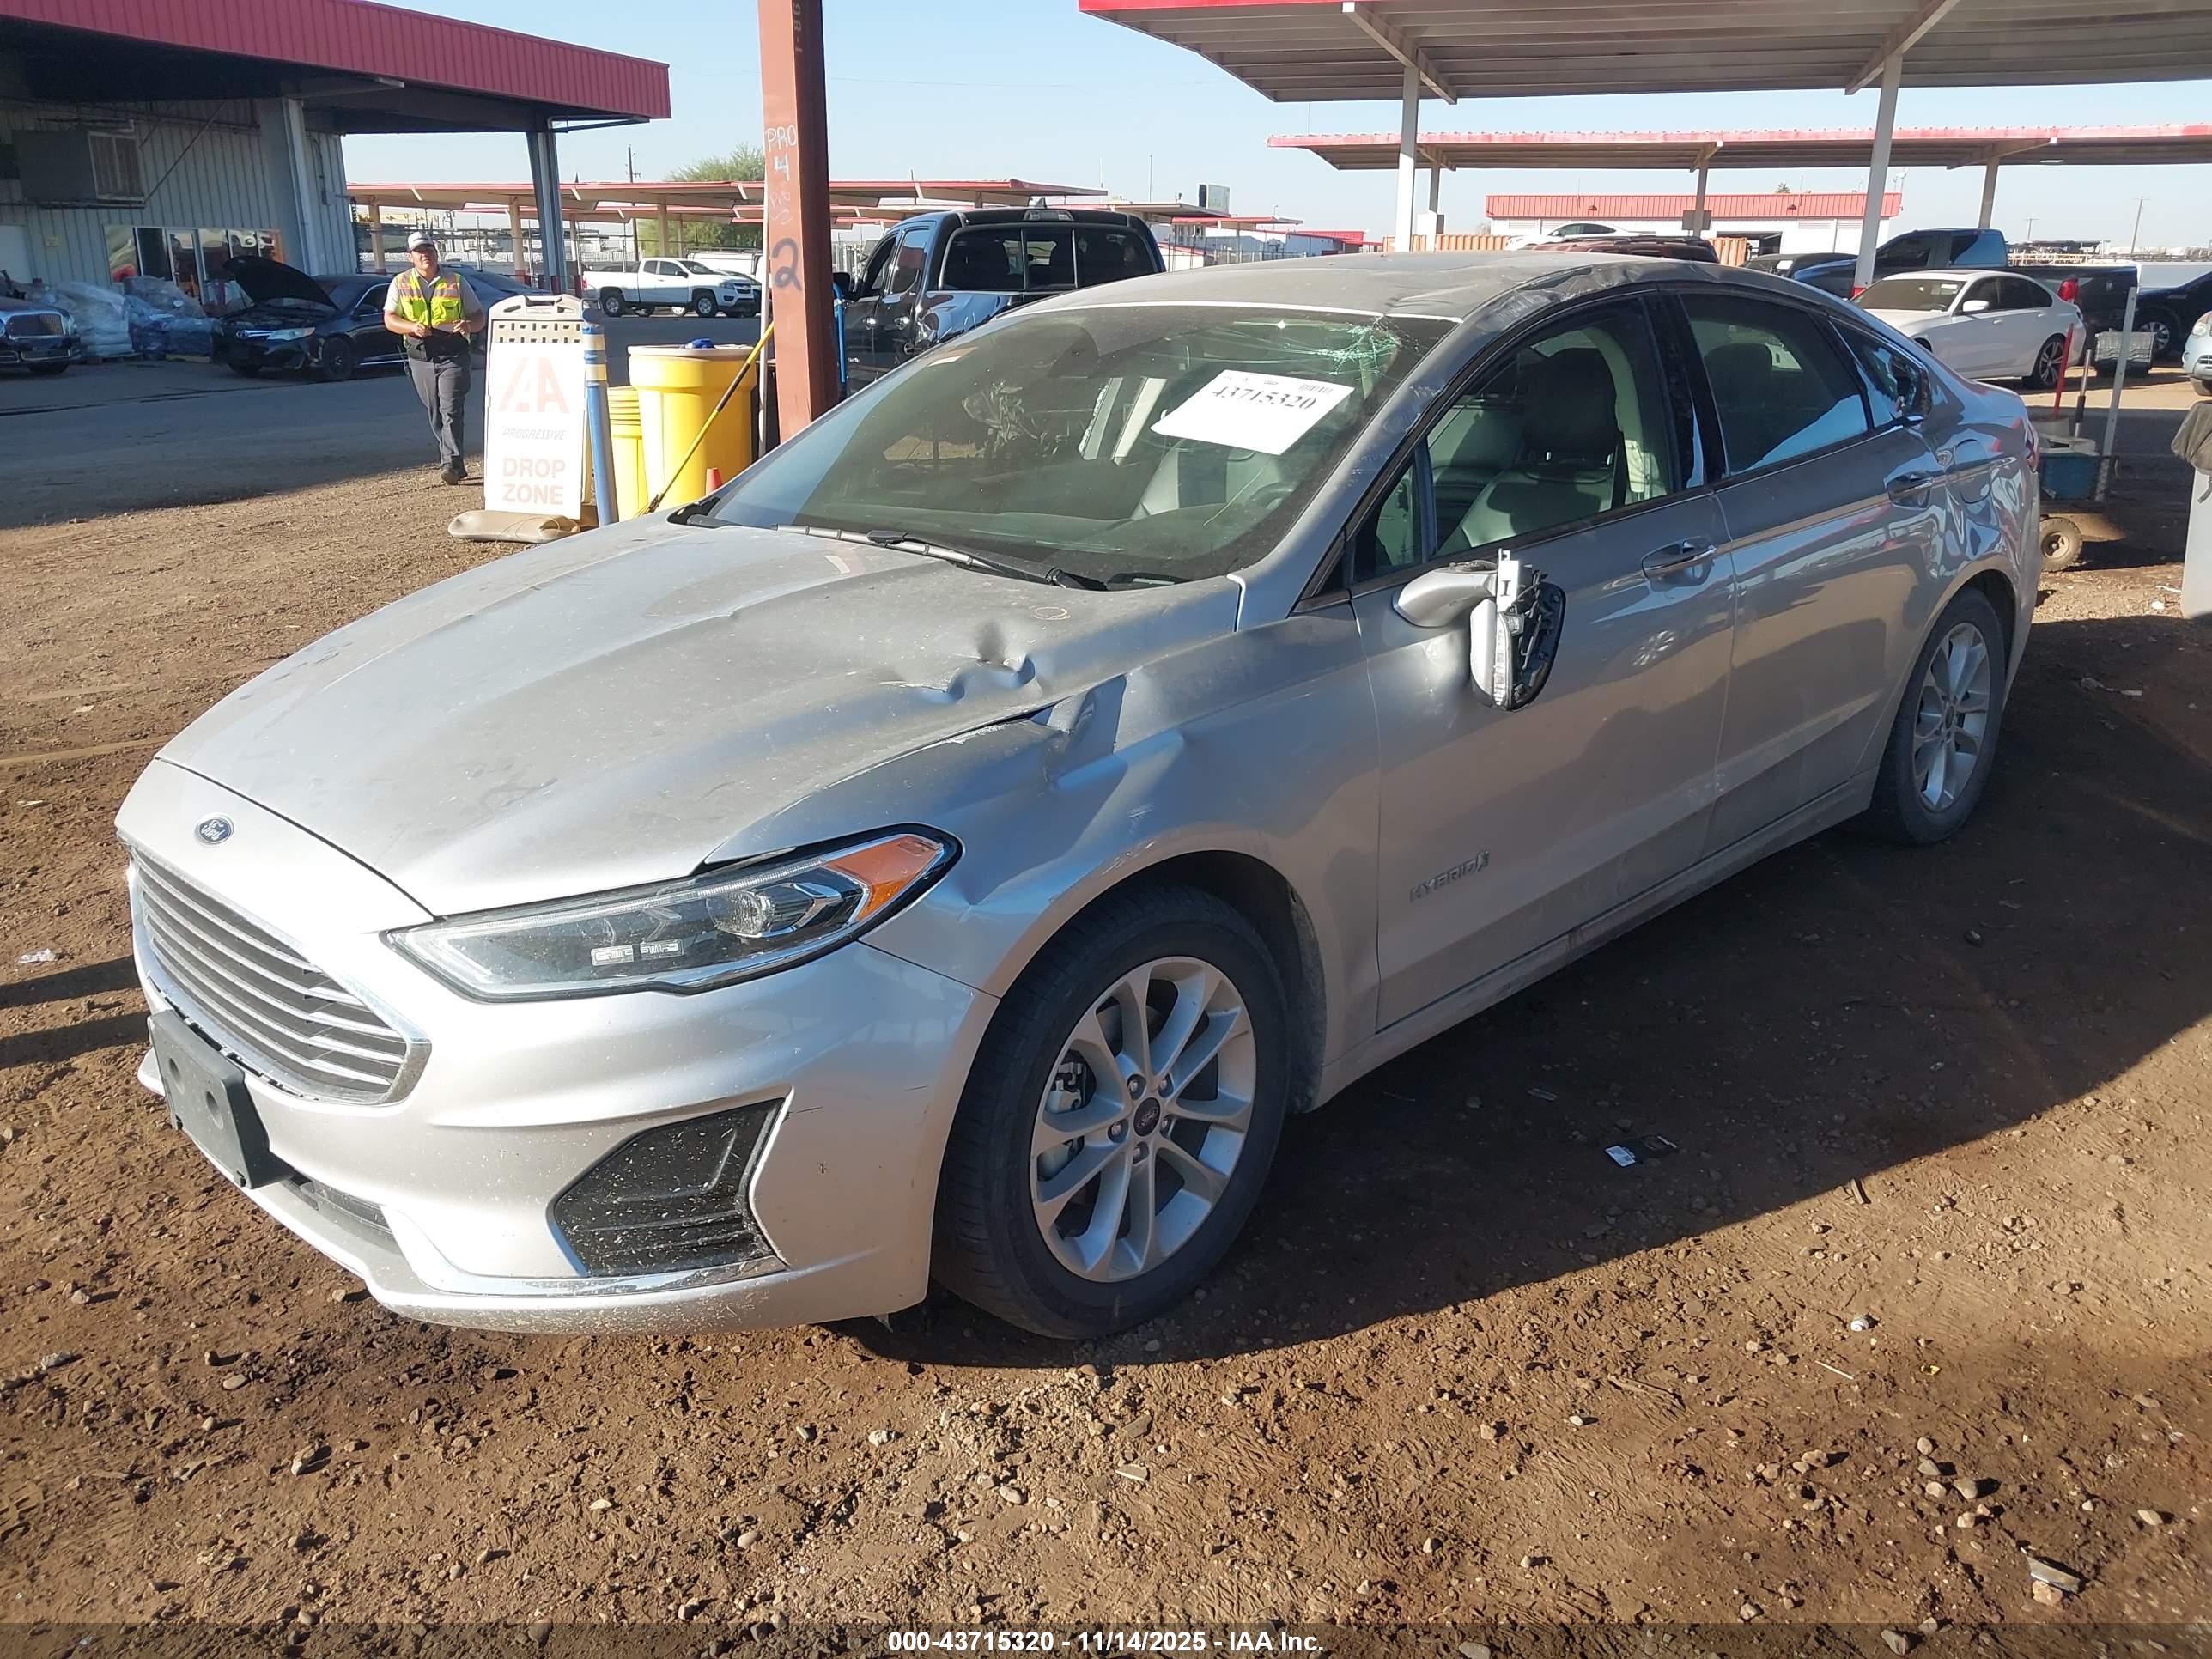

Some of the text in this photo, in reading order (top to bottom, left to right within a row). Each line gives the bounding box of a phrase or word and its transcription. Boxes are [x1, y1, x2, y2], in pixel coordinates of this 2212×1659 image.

[764, 125, 797, 152] PRO
[775, 151, 790, 181] 4
[772, 237, 802, 291] 2
[1212, 386, 1317, 410] 43715320
[502, 428, 567, 441] PROGRESSIVE
[502, 458, 566, 478] DROP
[501, 483, 563, 505] ZONE
[201, 819, 226, 841] Ford
